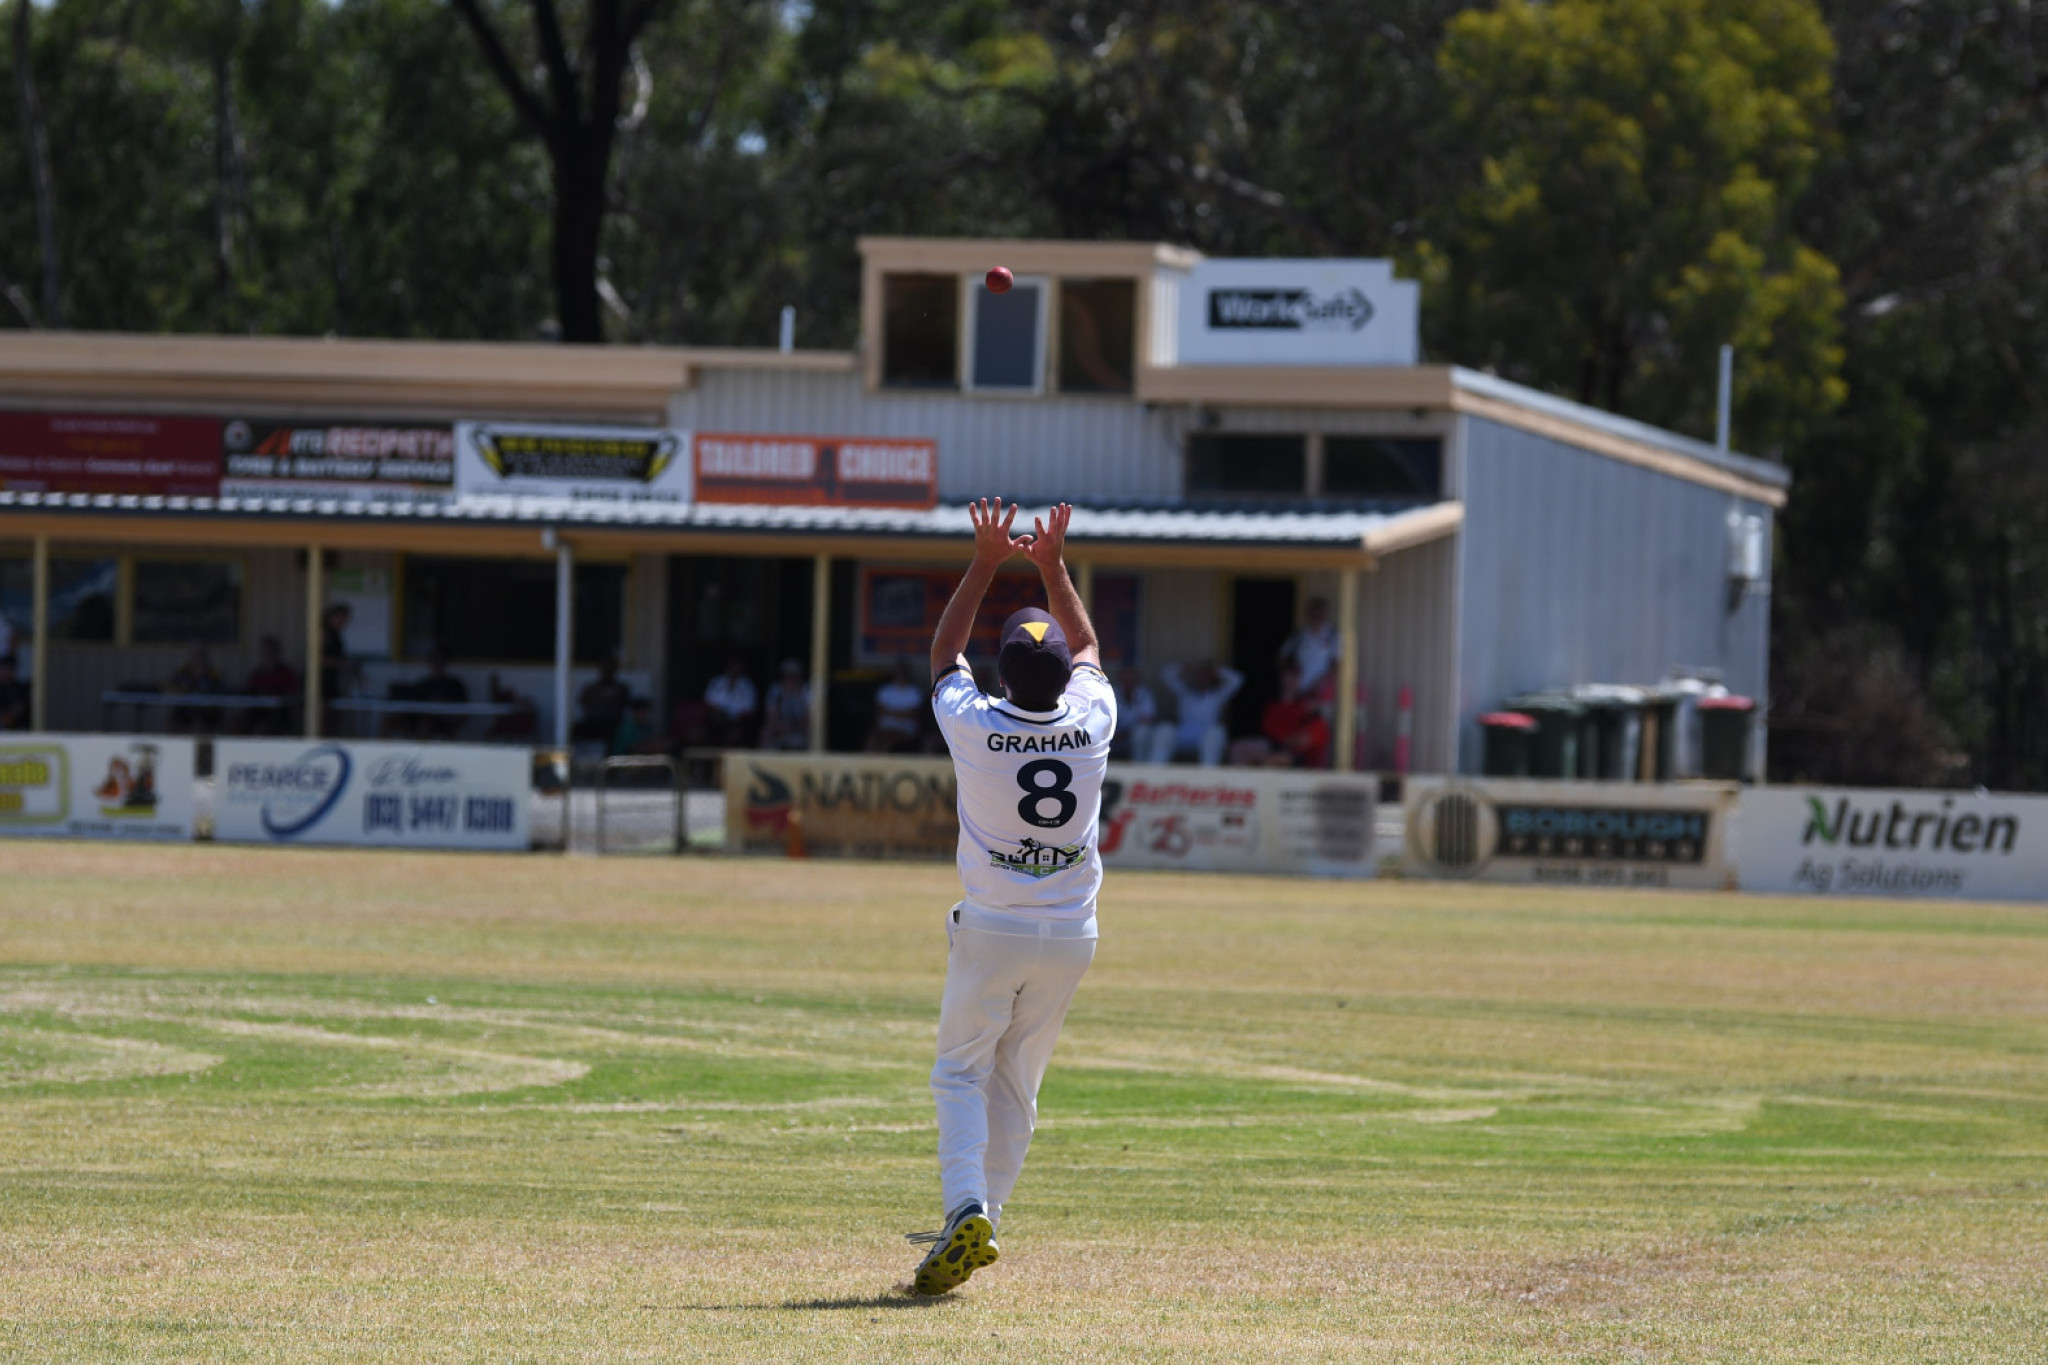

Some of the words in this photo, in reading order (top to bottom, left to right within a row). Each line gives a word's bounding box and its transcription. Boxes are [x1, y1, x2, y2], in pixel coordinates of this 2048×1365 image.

[699, 440, 815, 477] TAILORED
[838, 444, 929, 480] CHOICE
[987, 728, 1092, 753] GRAHAM
[228, 762, 328, 790] PEARCE
[1016, 758, 1077, 828] 8
[1507, 808, 1700, 840] BOROUGH
[1803, 795, 2020, 854] Nutrien
[1796, 857, 1834, 893] Ag
[1841, 859, 1966, 891] Solutions
